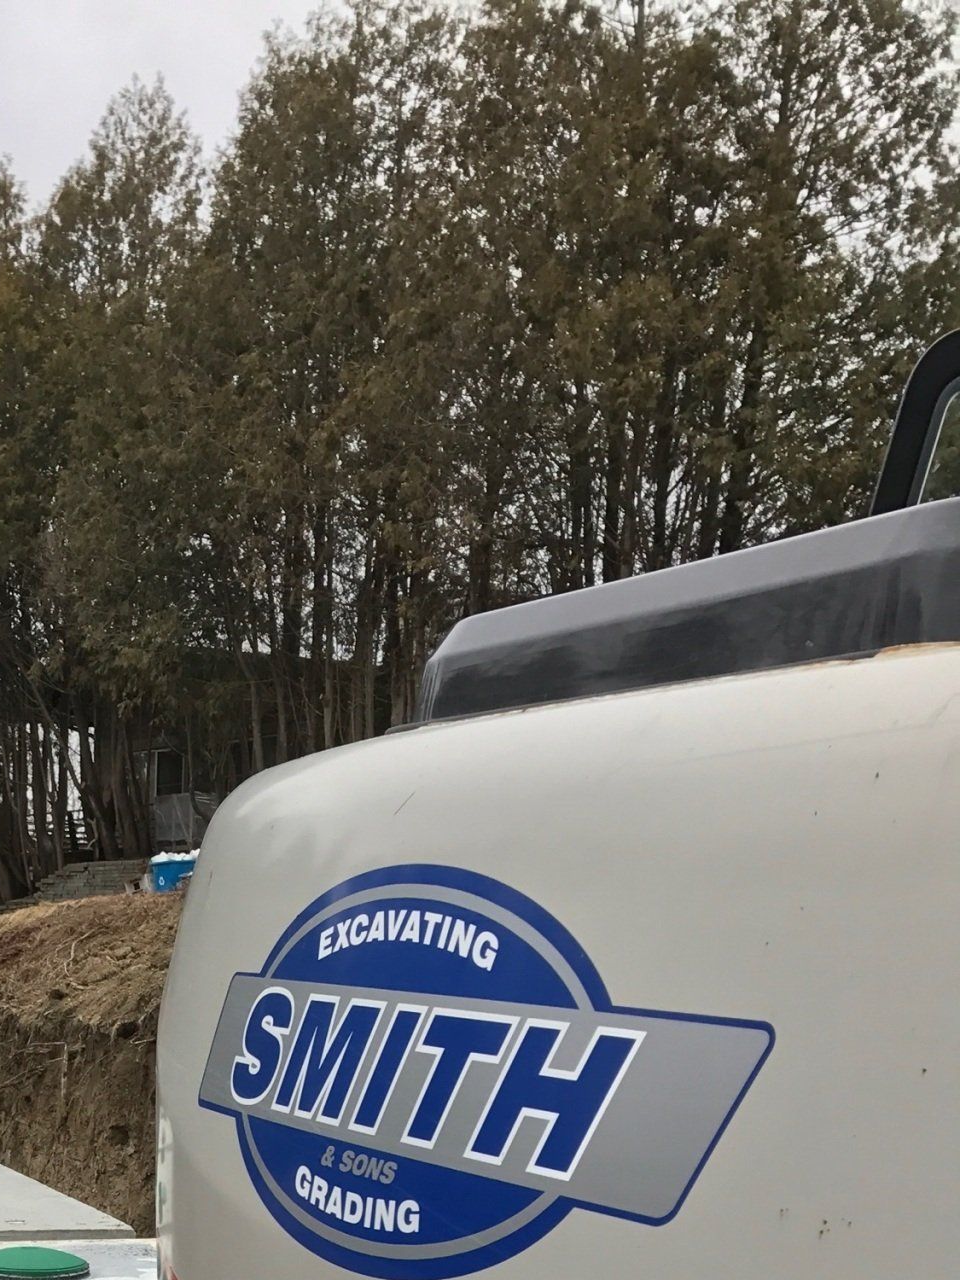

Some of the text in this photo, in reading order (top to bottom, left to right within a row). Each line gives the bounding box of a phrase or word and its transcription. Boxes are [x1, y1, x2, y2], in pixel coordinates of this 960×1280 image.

[318, 910, 499, 971] EXCAVATING
[230, 986, 647, 1182] SMITH
[321, 1146, 397, 1184] & SONS
[295, 1166, 420, 1233] GRADING
